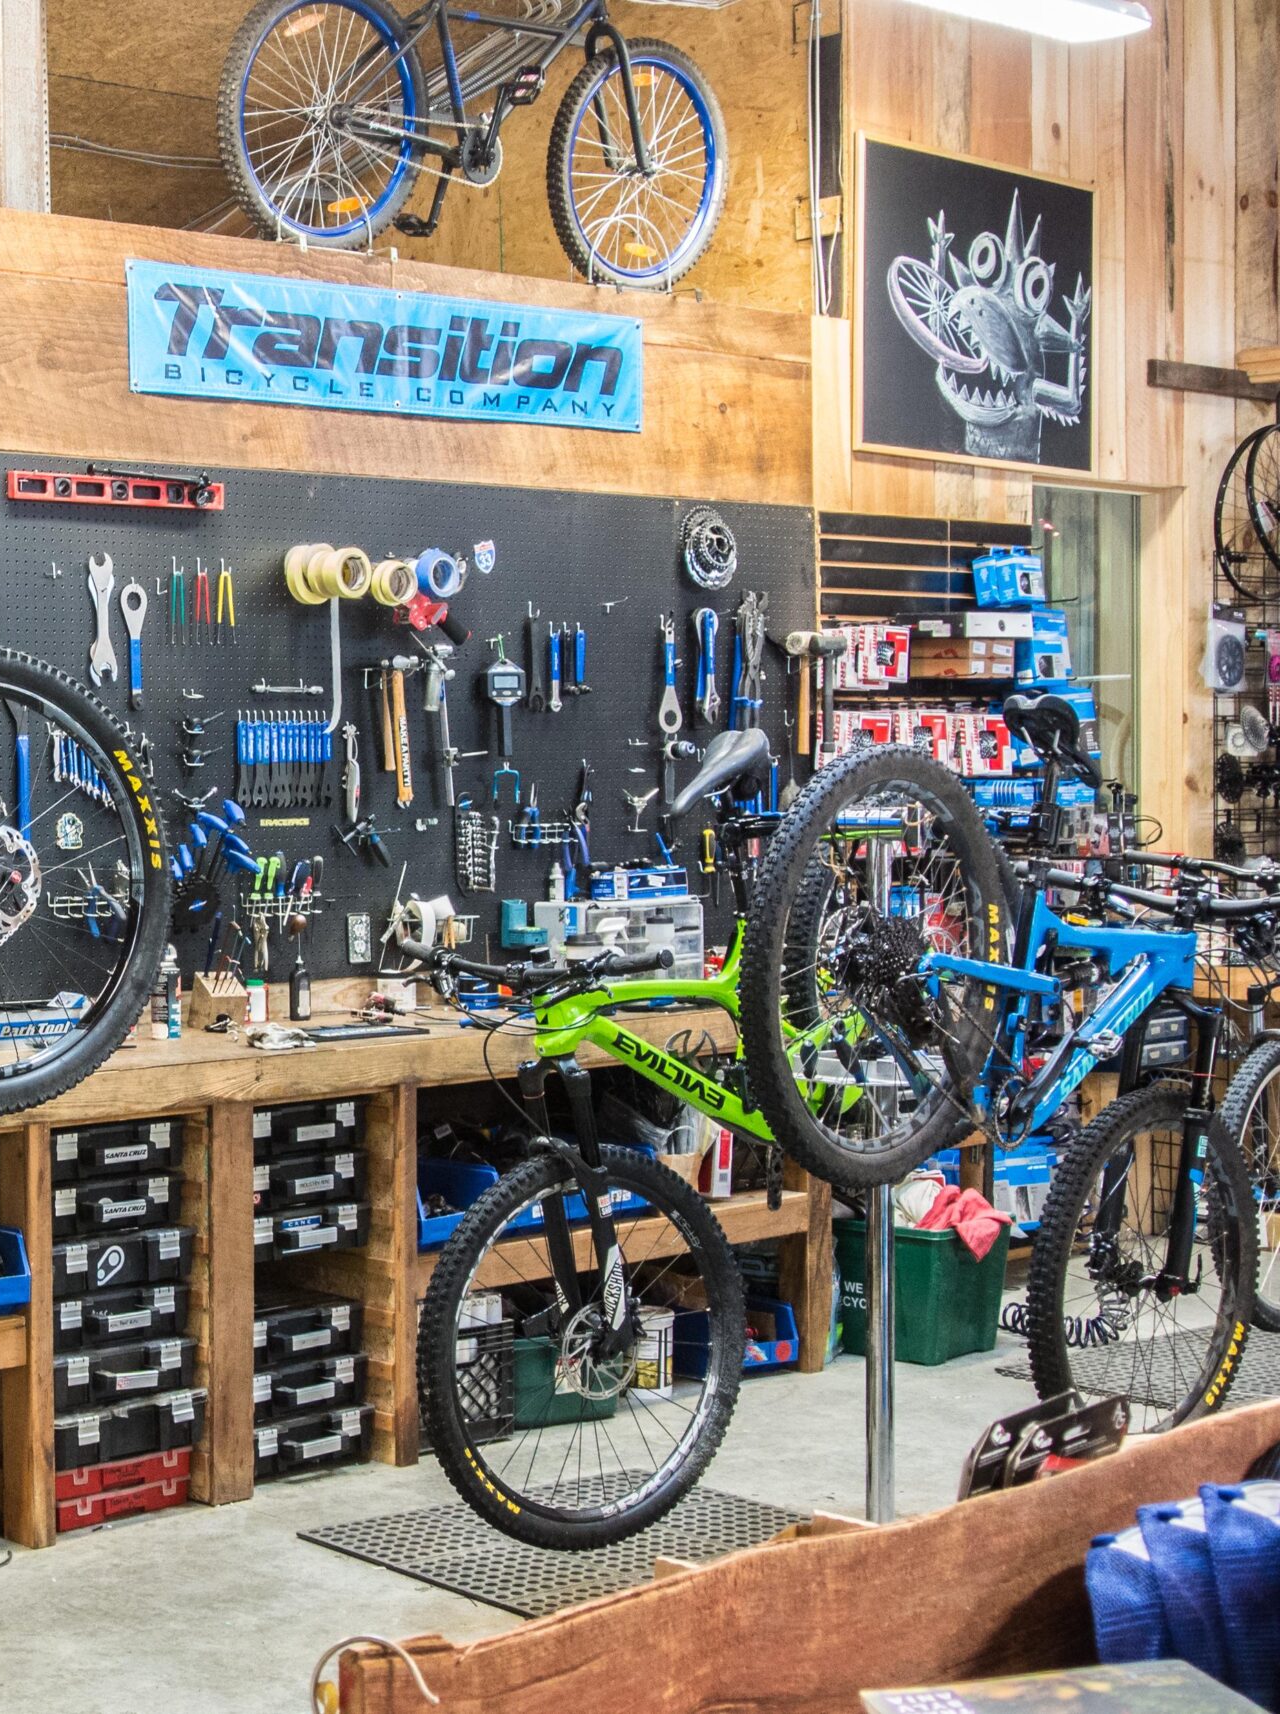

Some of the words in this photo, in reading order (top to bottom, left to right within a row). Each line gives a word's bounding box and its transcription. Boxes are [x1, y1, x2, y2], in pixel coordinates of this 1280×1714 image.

[153, 281, 625, 396] Transition
[164, 363, 375, 398] BICYCLE
[416, 386, 618, 416] COMPANY
[113, 750, 162, 870] MAXXIS
[984, 903, 1000, 1012] MAXIS
[287, 1219, 312, 1227] CANE
[843, 1280, 864, 1295] WE
[1205, 1320, 1245, 1406] MAXXIS
[464, 1447, 522, 1515] MAXXIS
